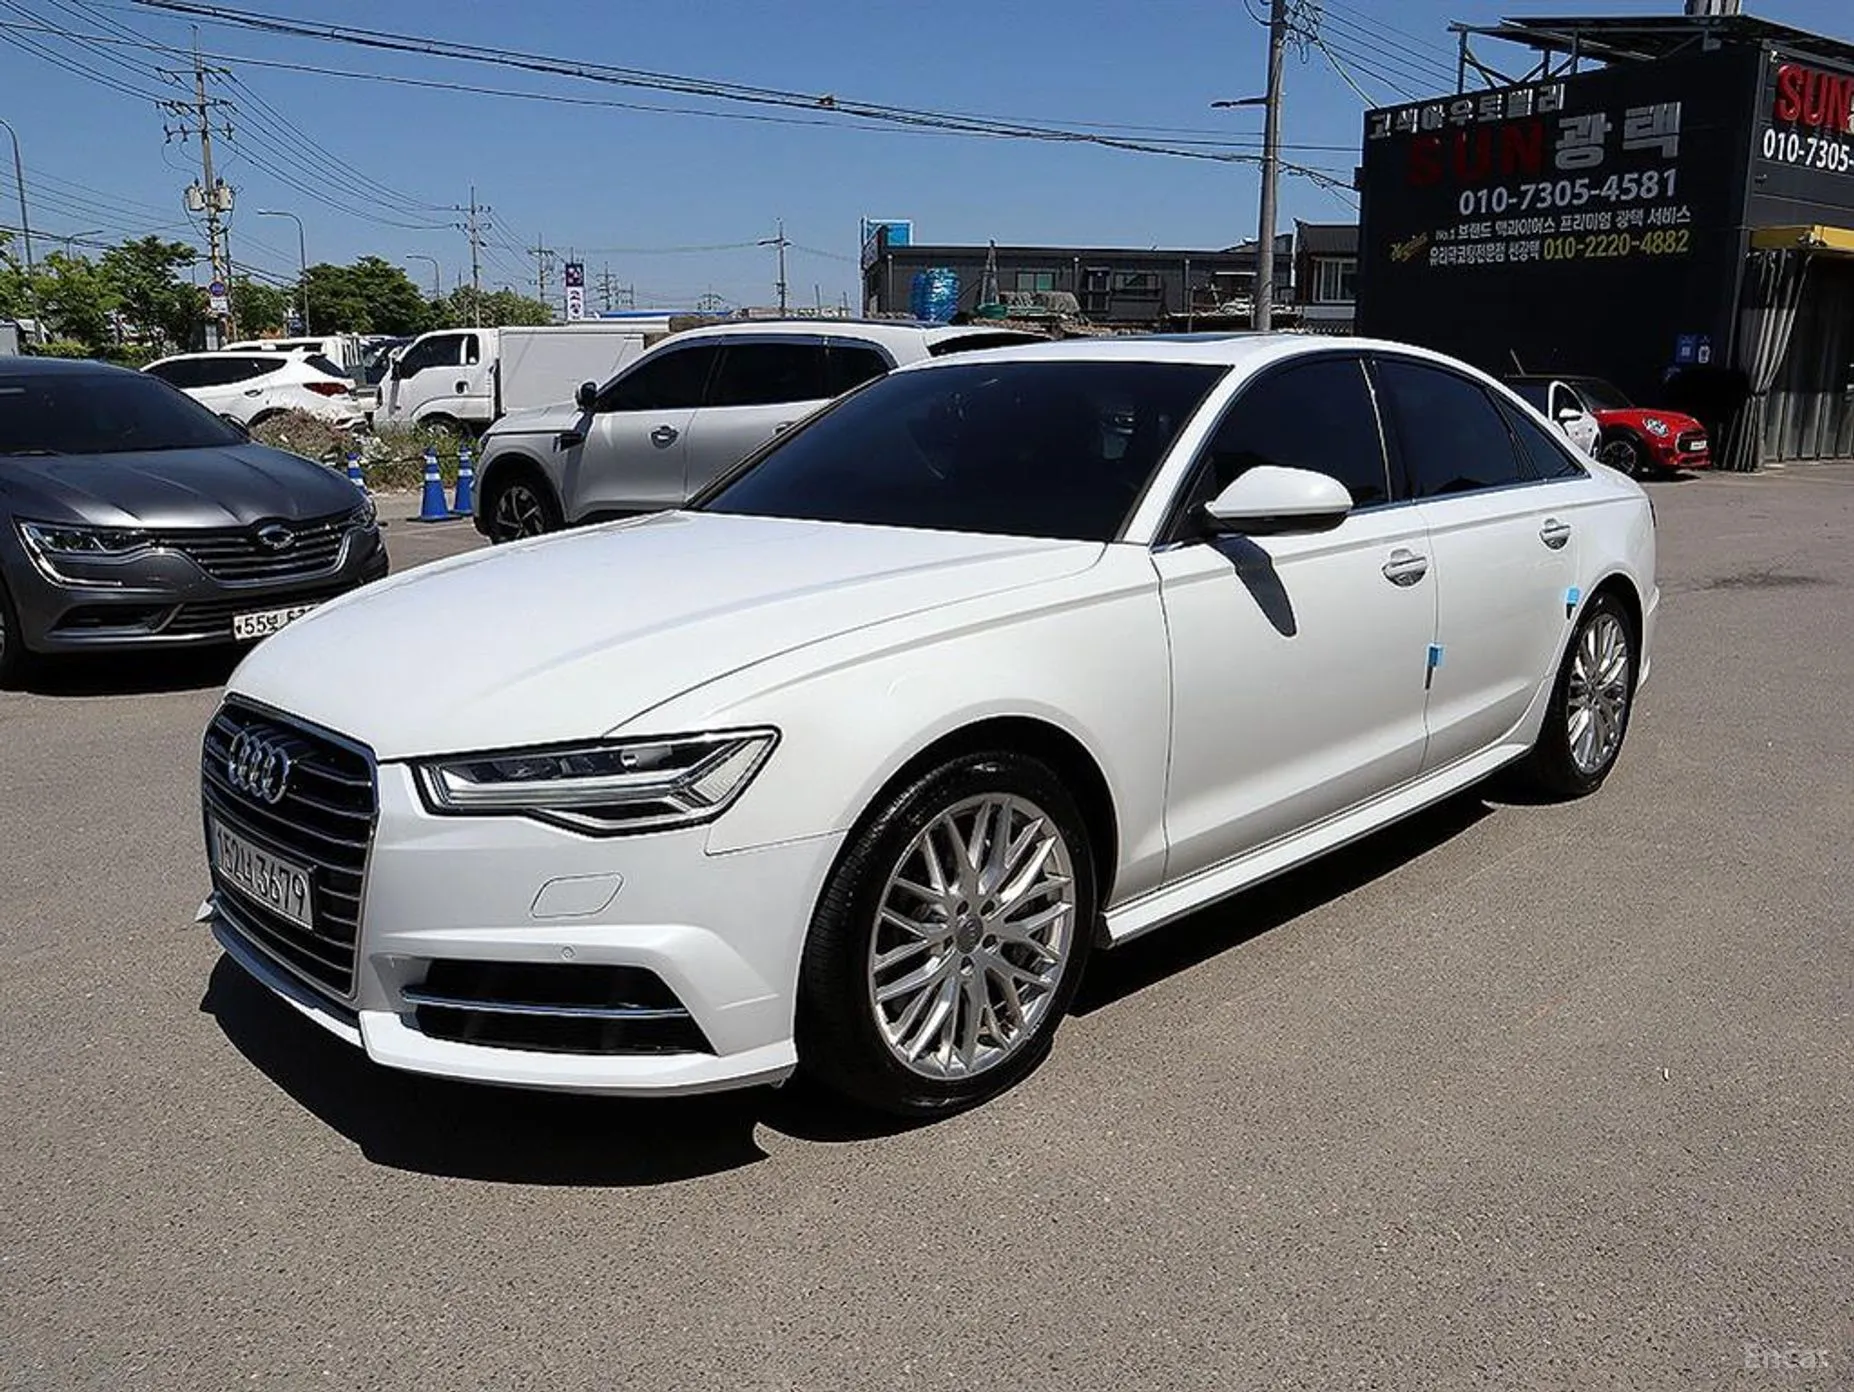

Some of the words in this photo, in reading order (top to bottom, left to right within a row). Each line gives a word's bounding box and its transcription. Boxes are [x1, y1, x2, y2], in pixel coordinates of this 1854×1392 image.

[1774, 64, 1854, 131] SUN
[1406, 122, 1546, 186] SUN
[1554, 101, 1682, 170] 광택
[1458, 168, 1678, 216] 010-7305-4581
[1560, 211, 1612, 231] 프리미엄
[1615, 207, 1644, 229] 광택
[1647, 204, 1692, 226] 서비스
[1544, 229, 1690, 260] 010-2220-4882
